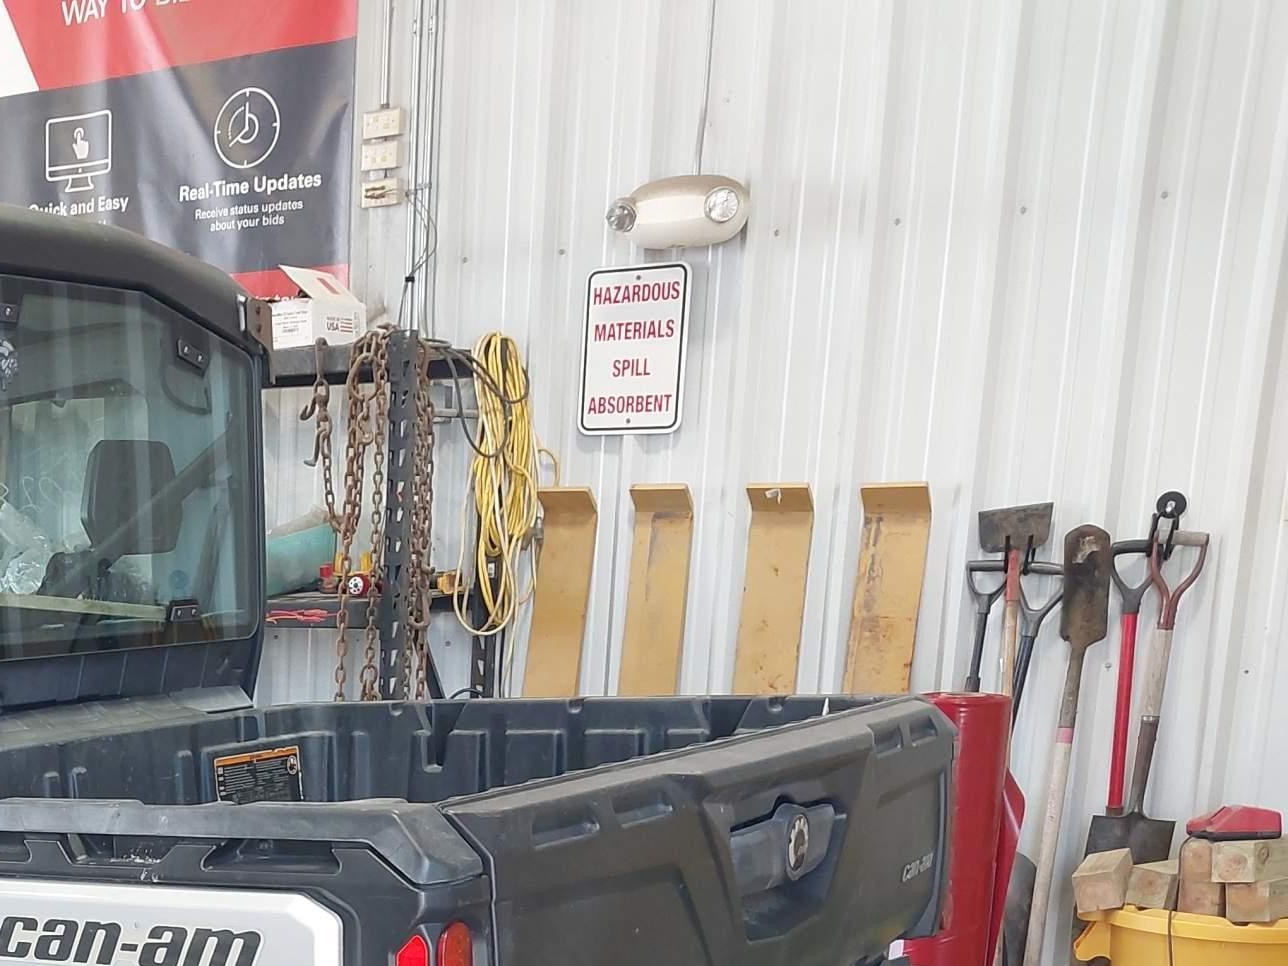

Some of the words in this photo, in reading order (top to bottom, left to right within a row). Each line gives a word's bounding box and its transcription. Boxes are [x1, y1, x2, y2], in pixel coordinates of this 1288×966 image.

[179, 180, 249, 202] Real-Time
[254, 173, 322, 195] Updates
[29, 202, 67, 217] ick
[70, 198, 94, 215] and
[98, 196, 129, 212] Easy
[195, 207, 229, 220] Receive
[230, 204, 259, 215] status
[262, 200, 303, 213] updates
[210, 220, 235, 232] about
[237, 218, 260, 231] your
[262, 214, 285, 226] bids
[593, 281, 680, 305] HAZARDOUS
[327, 321, 339, 331] USA
[594, 319, 675, 342] MATERIALS
[612, 358, 651, 377] SPILL
[588, 394, 672, 414] ABSORBENT
